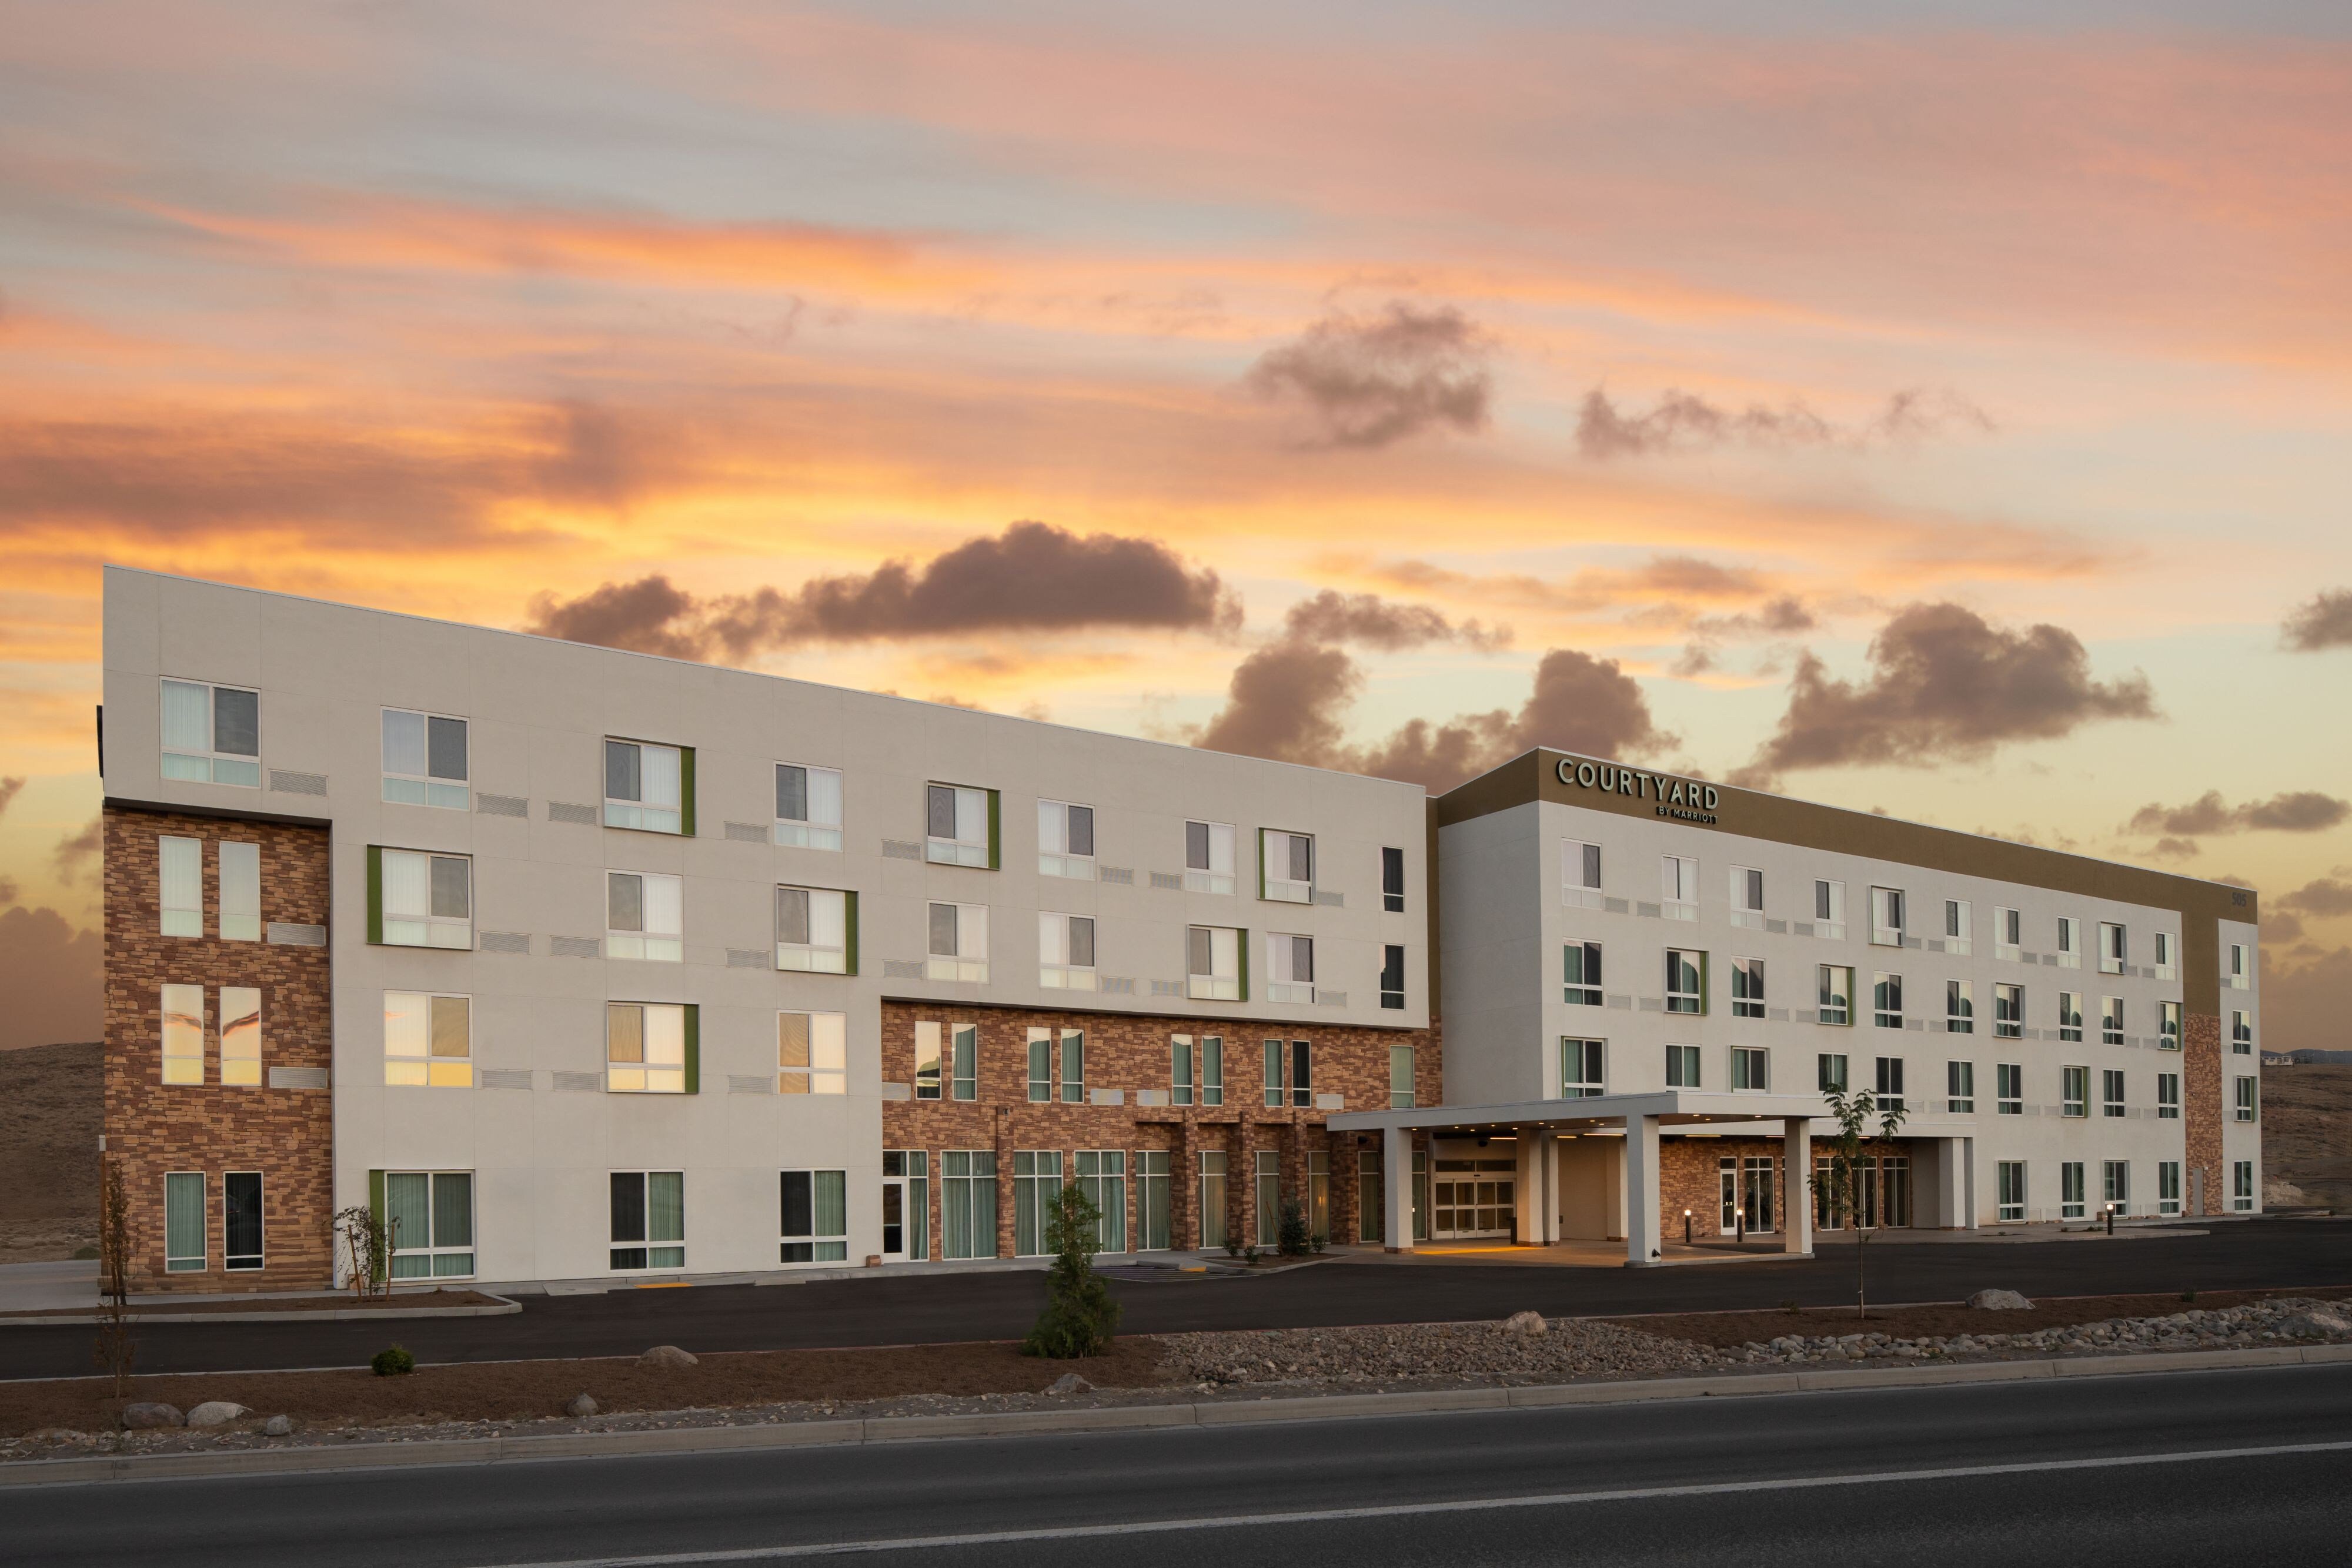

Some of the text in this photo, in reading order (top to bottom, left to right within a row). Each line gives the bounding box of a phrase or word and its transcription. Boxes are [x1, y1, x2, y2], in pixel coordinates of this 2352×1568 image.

[1558, 758, 1719, 810] COURTYARD
[1658, 805, 1718, 824] BY MARRIOTT
[2231, 892, 2247, 907] 505
